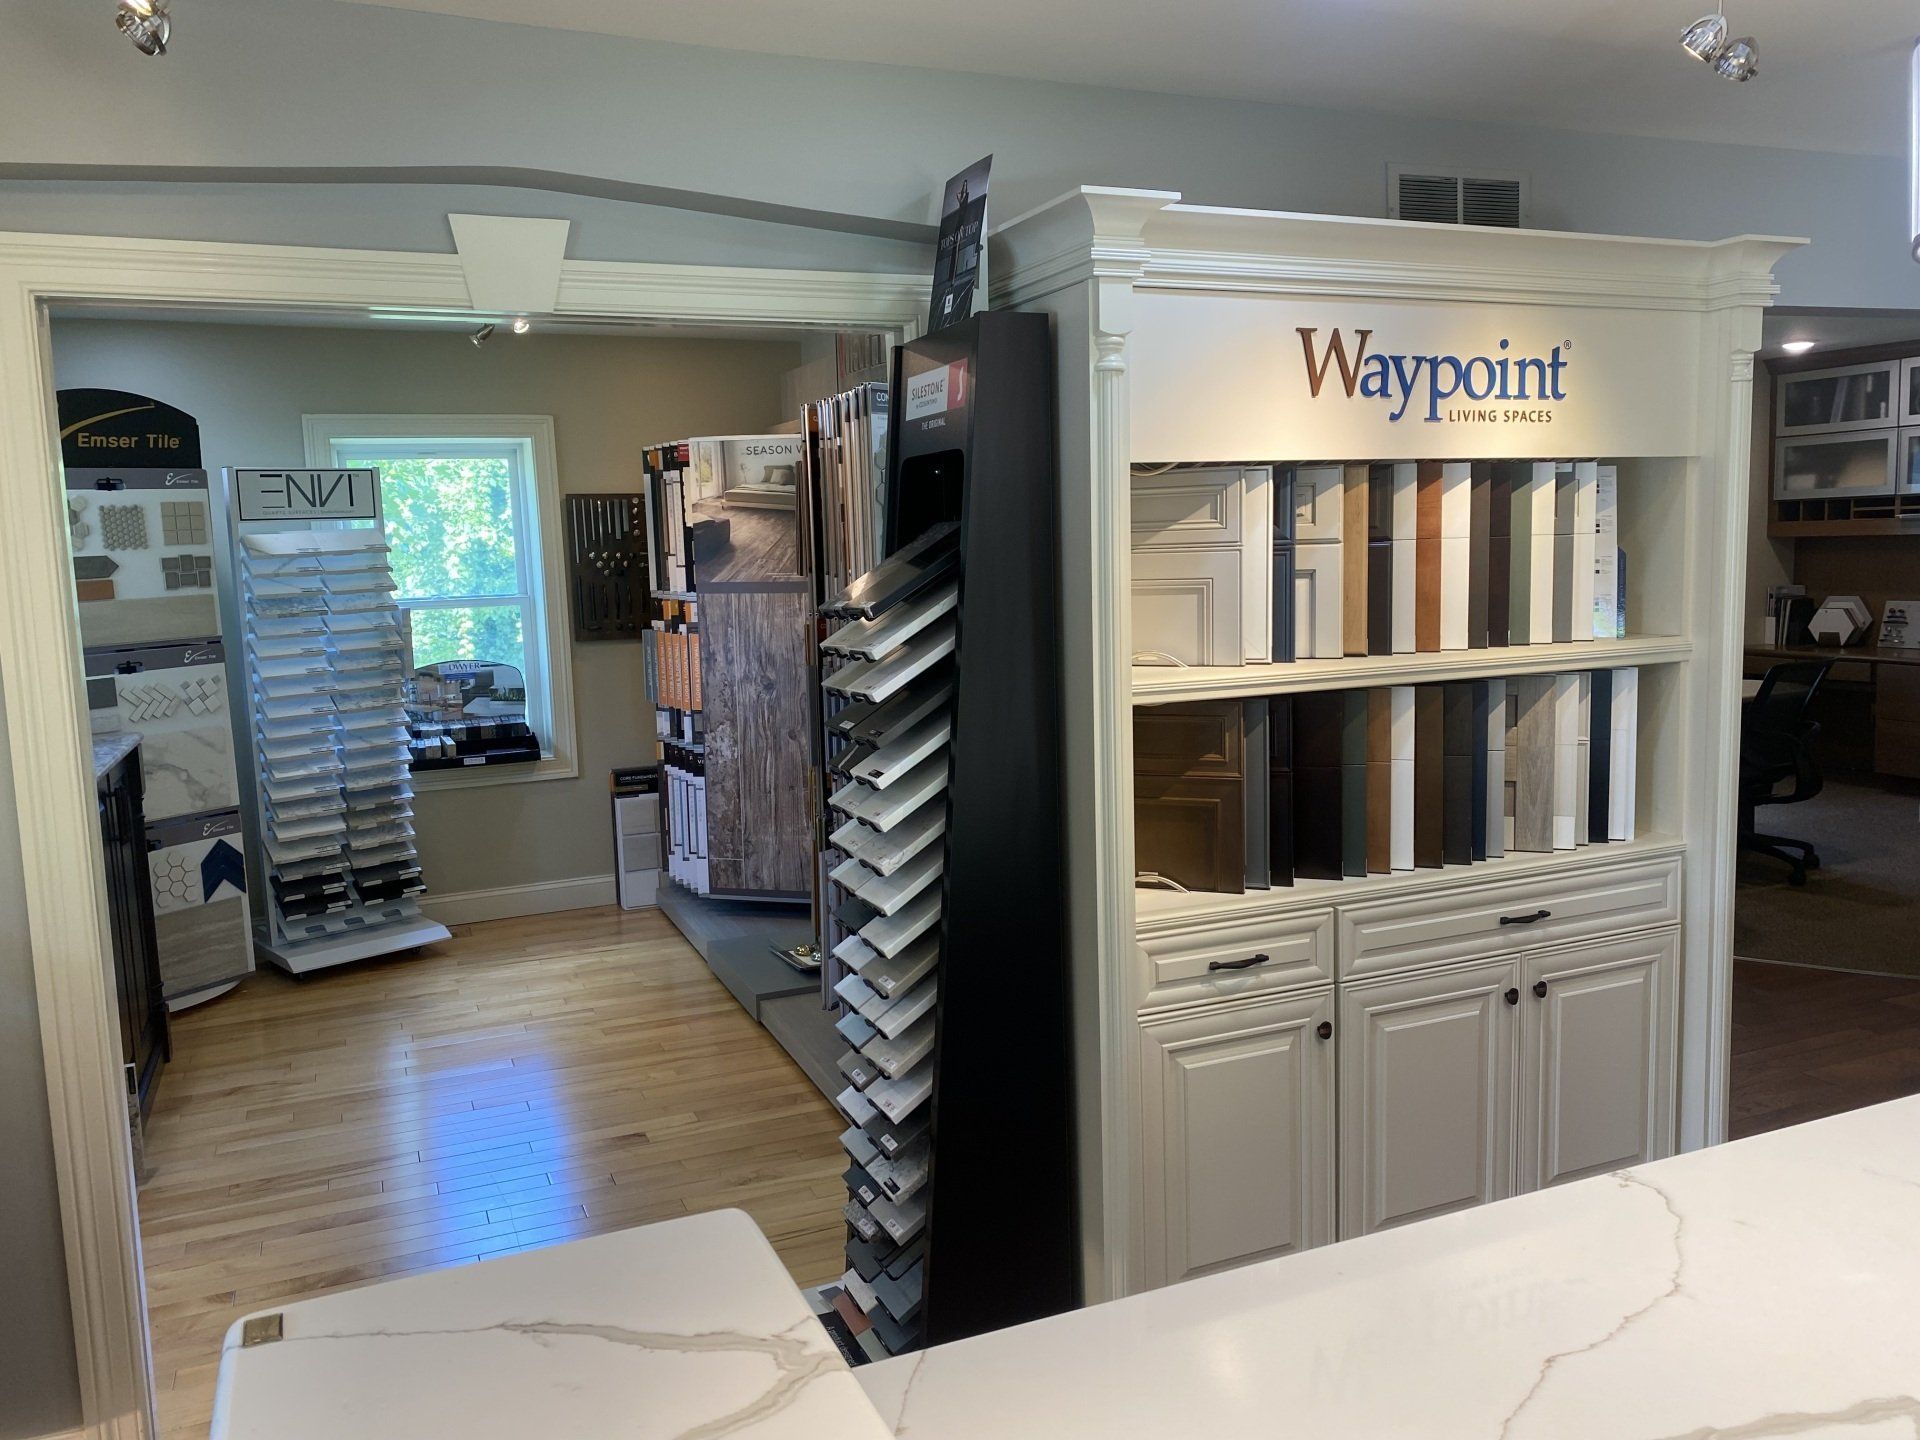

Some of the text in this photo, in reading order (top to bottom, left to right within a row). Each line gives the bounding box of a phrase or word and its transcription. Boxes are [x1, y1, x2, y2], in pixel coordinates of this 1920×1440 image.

[1295, 327, 1568, 423] Waypoint
[912, 379, 944, 401] SILESTONE
[1449, 410, 1552, 423] LIVING SPACES
[77, 432, 180, 449] Emser Tile
[746, 445, 792, 456] SEASON
[260, 473, 354, 509] ENVI
[448, 662, 480, 671] DWYER
